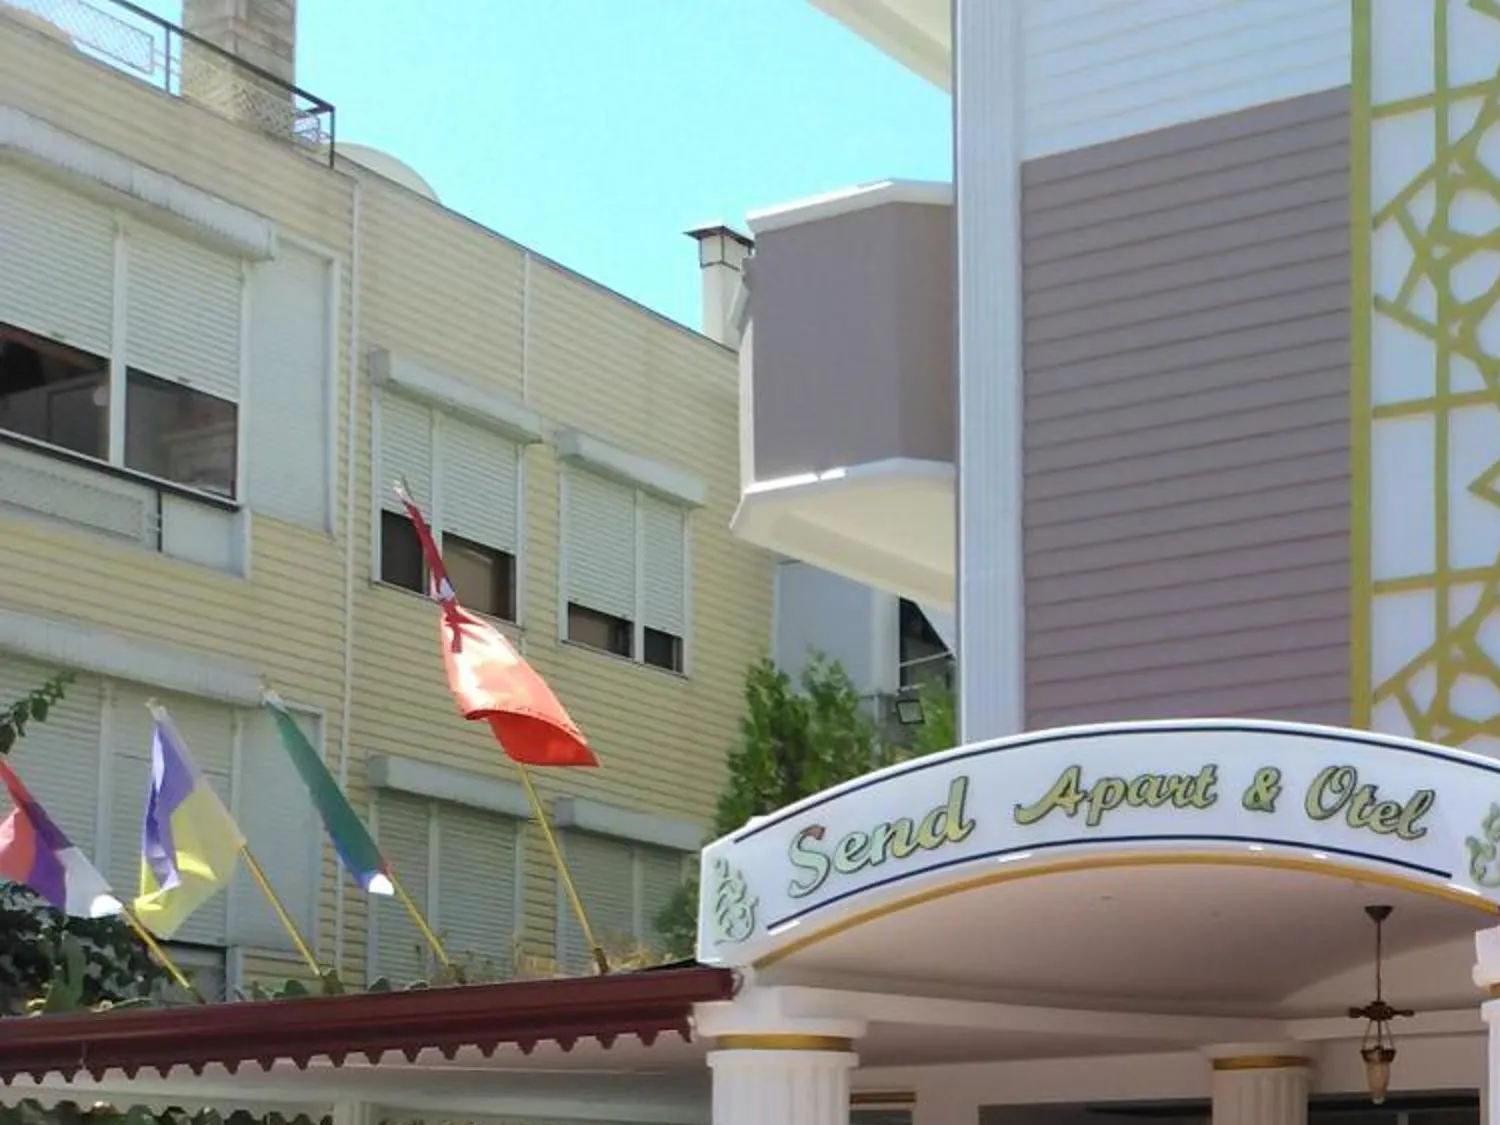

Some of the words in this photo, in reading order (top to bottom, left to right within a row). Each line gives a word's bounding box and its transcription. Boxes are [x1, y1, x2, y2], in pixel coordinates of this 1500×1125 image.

[788, 775, 977, 899] Send
[1013, 764, 1219, 827] Apart
[1241, 765, 1283, 814] &
[1303, 765, 1436, 841] Otel
